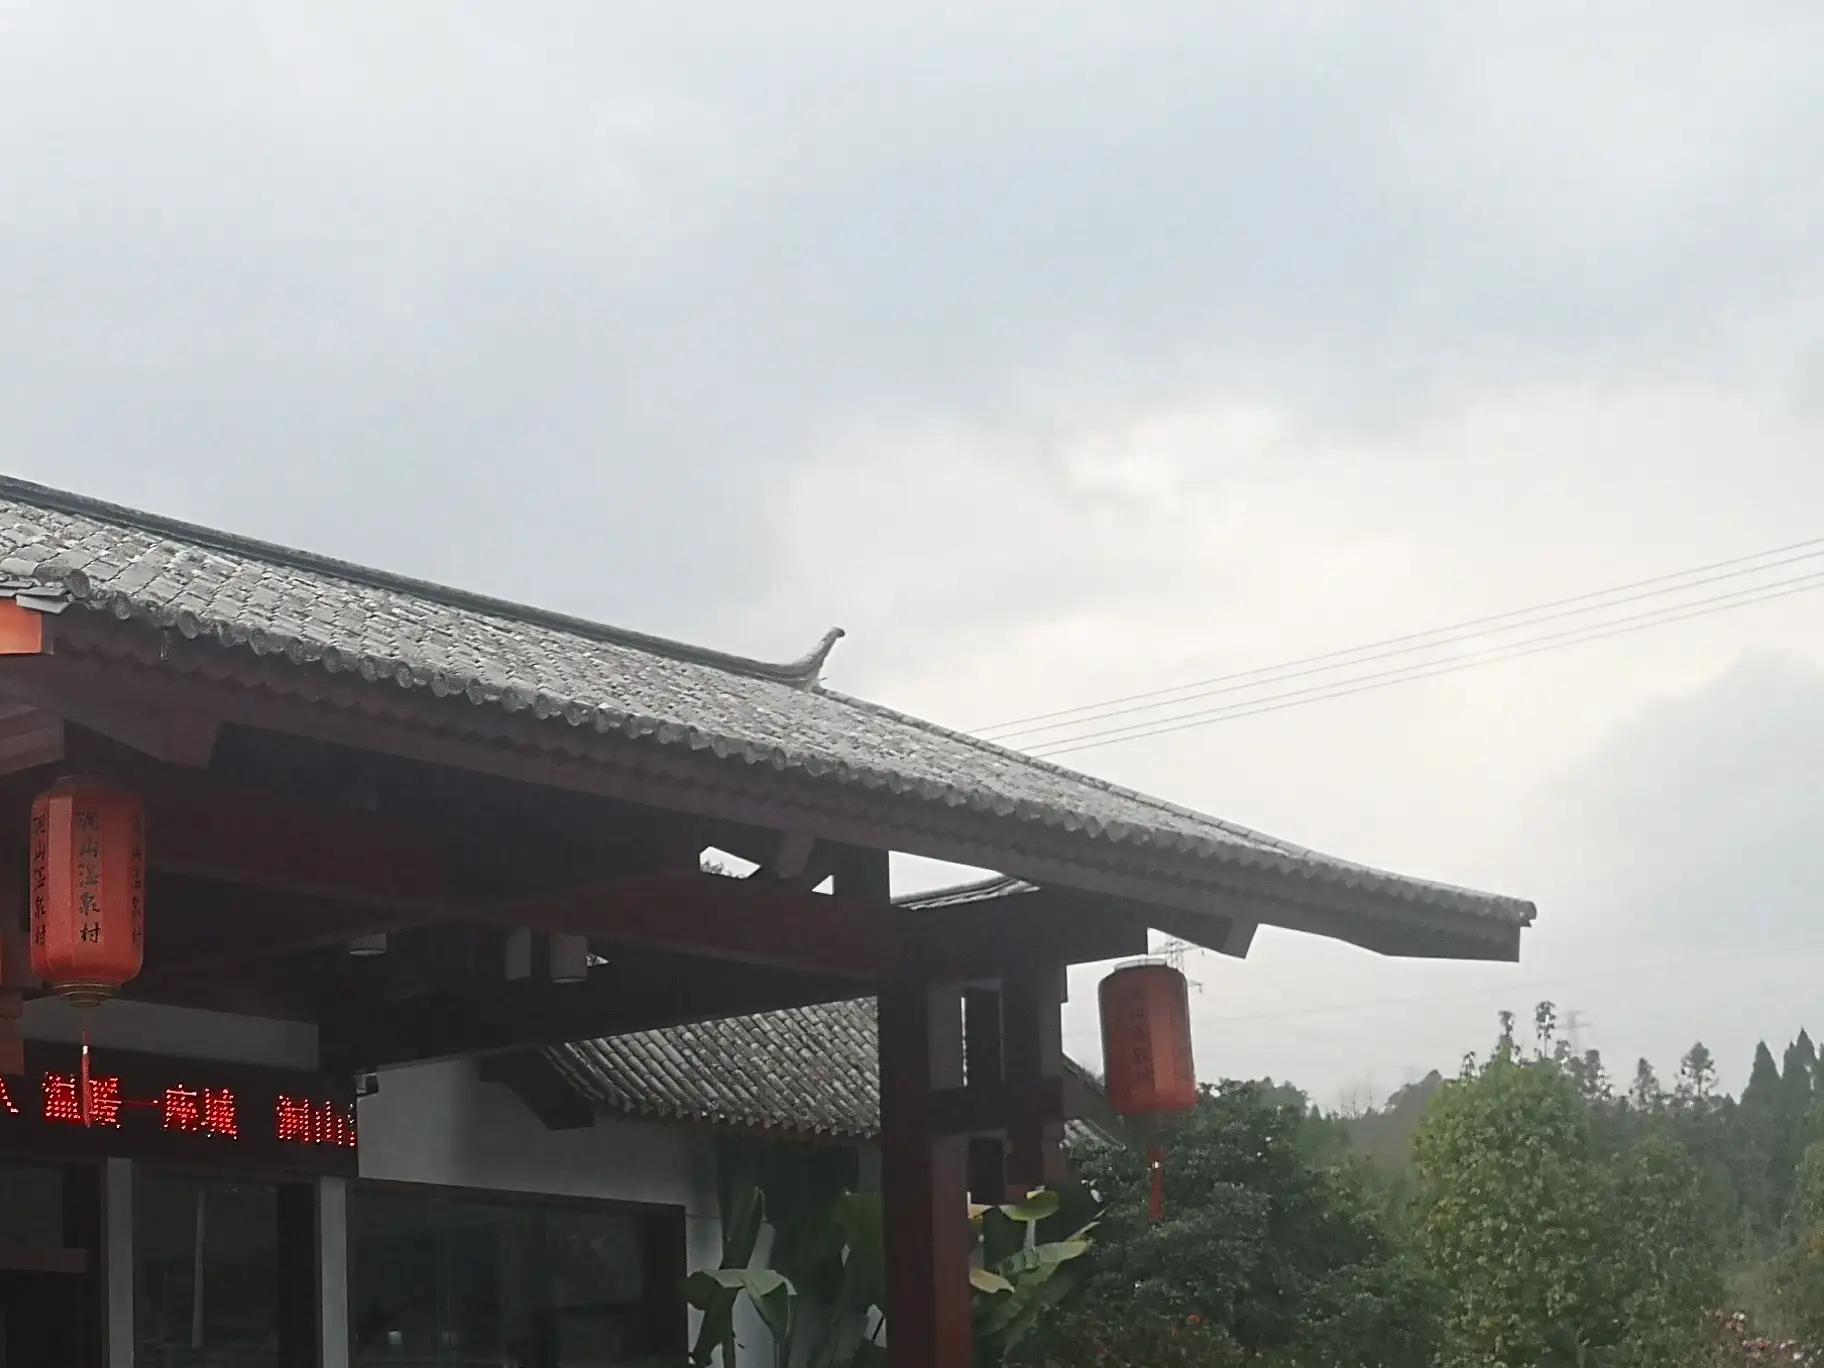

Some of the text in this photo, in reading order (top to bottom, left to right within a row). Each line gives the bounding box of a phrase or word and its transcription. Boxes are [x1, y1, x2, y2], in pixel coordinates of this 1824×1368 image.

[76, 811, 103, 944] 洞山温泉村
